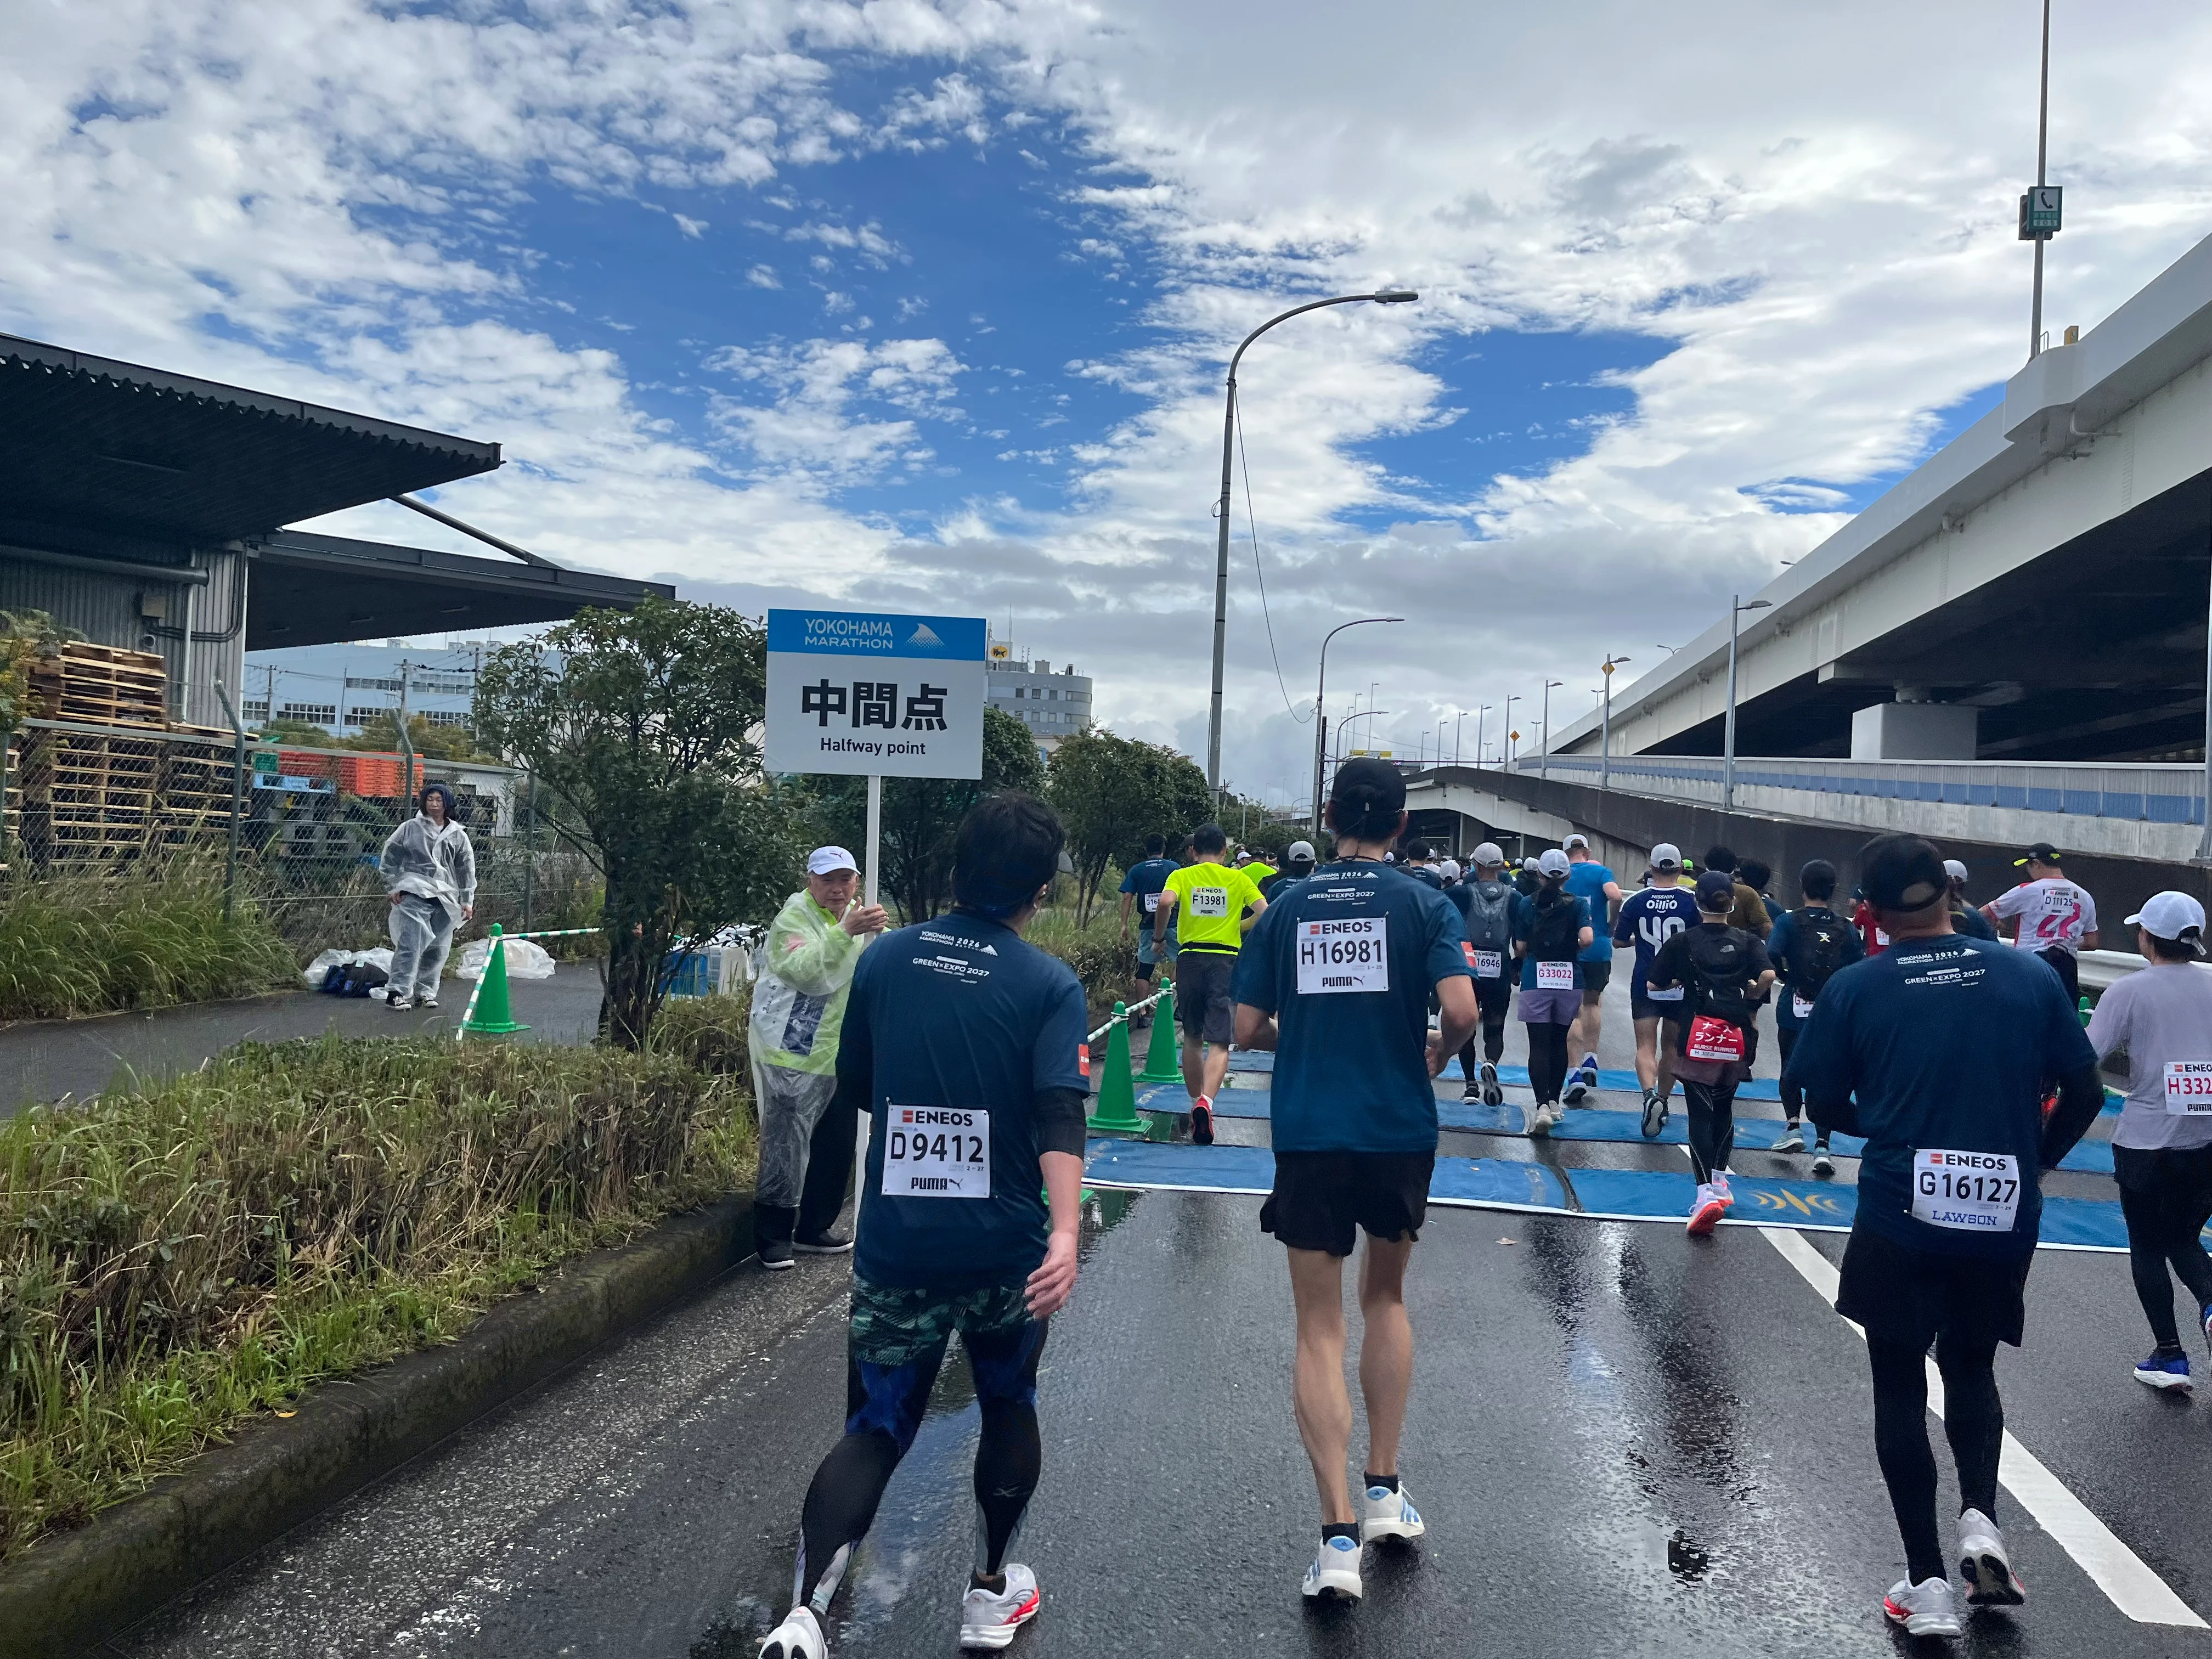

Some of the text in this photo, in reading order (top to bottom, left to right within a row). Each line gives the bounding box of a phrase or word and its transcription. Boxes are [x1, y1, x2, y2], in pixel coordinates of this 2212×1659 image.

[805, 618, 893, 637] YOKOHAMA
[805, 636, 893, 649] MARATHON
[802, 679, 948, 731] 中間点
[821, 737, 926, 757] Halfway point
[1193, 895, 1226, 906] F13981
[2045, 896, 2073, 906] D11125
[1322, 921, 1373, 934] ENEOS
[919, 936, 953, 946] MARATHON
[921, 930, 955, 941] YOKOHAMA
[956, 937, 980, 948] 2026
[1301, 939, 1381, 965] H16981
[1896, 953, 1933, 962] YOKOHAMA
[1934, 950, 1959, 958] 2026
[1476, 958, 1500, 968] 16946
[967, 967, 990, 978] 2027
[1538, 969, 1572, 979] G33022
[1962, 969, 1985, 978] 2027
[1322, 976, 1353, 988] PUMA
[1702, 1021, 1733, 1034] ナース
[1695, 1031, 1738, 1044] ランナー
[2185, 1064, 2212, 1072] ENEO
[2168, 1077, 2212, 1094] H332
[915, 1110, 973, 1127] ENEOS
[890, 1132, 984, 1163] D9412
[1945, 1154, 2006, 1171] ENEOS
[911, 1177, 947, 1190] PUMA
[1920, 1171, 2018, 1203] G16127
[1932, 1210, 1997, 1226] LAWSON
